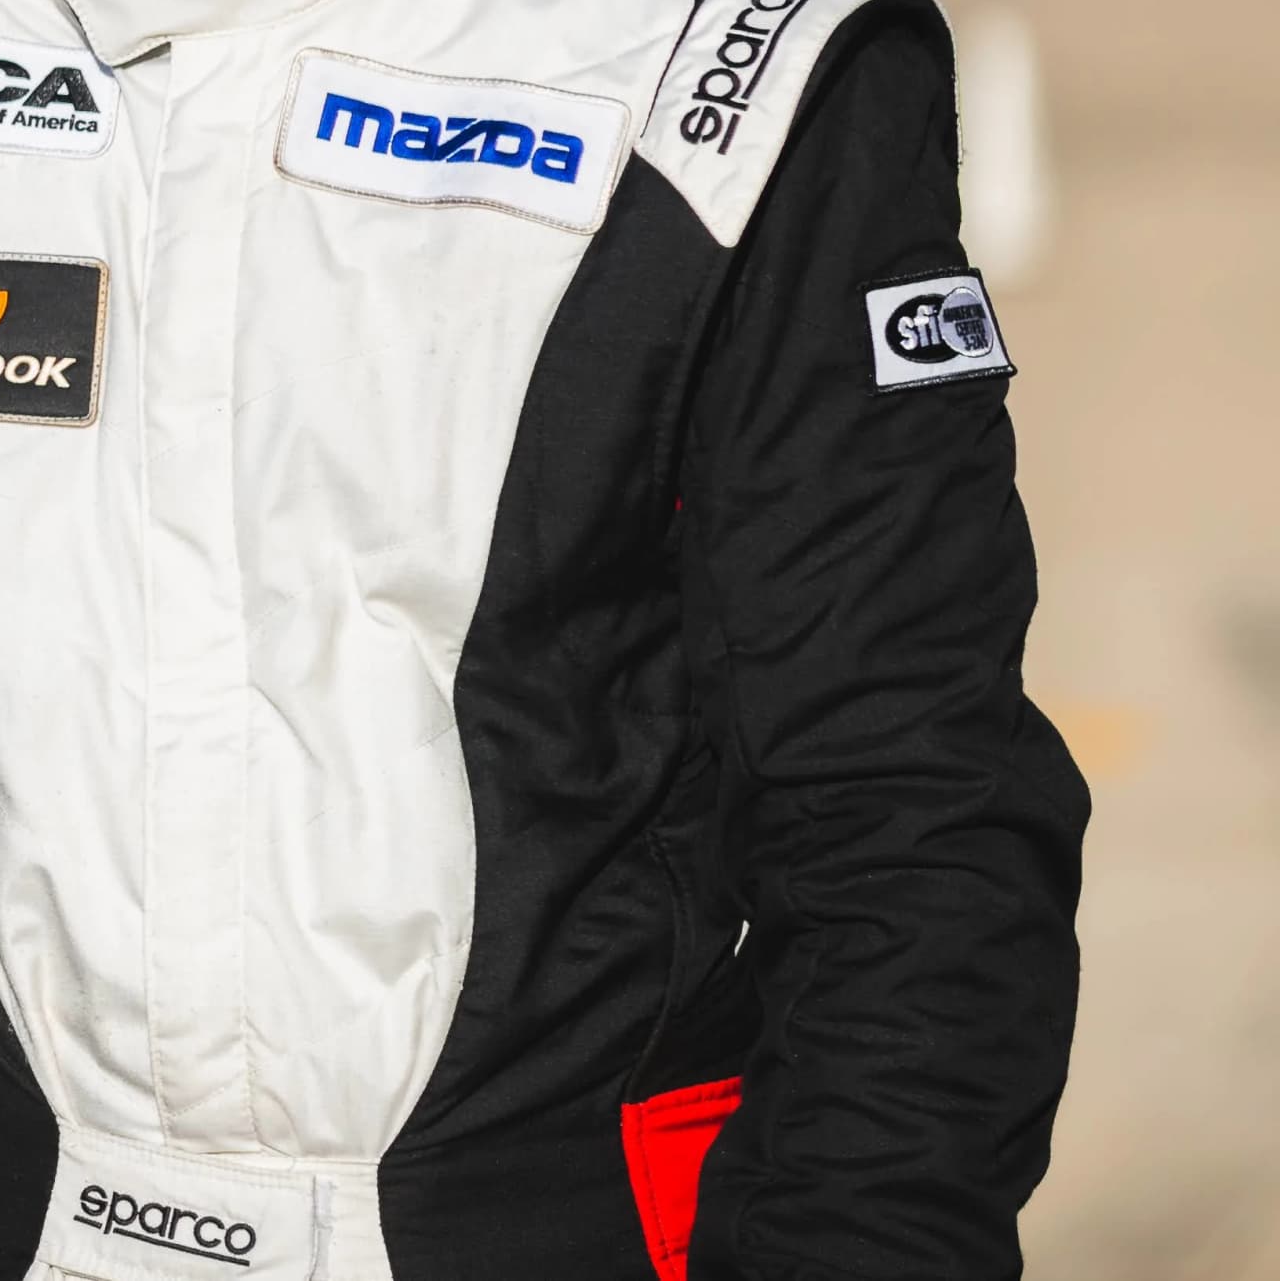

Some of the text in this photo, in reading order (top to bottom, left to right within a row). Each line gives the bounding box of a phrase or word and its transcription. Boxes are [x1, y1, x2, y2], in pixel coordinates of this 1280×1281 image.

[11, 109, 99, 133] America
[316, 92, 584, 184] mazda
[80, 1184, 257, 1256] sparco
